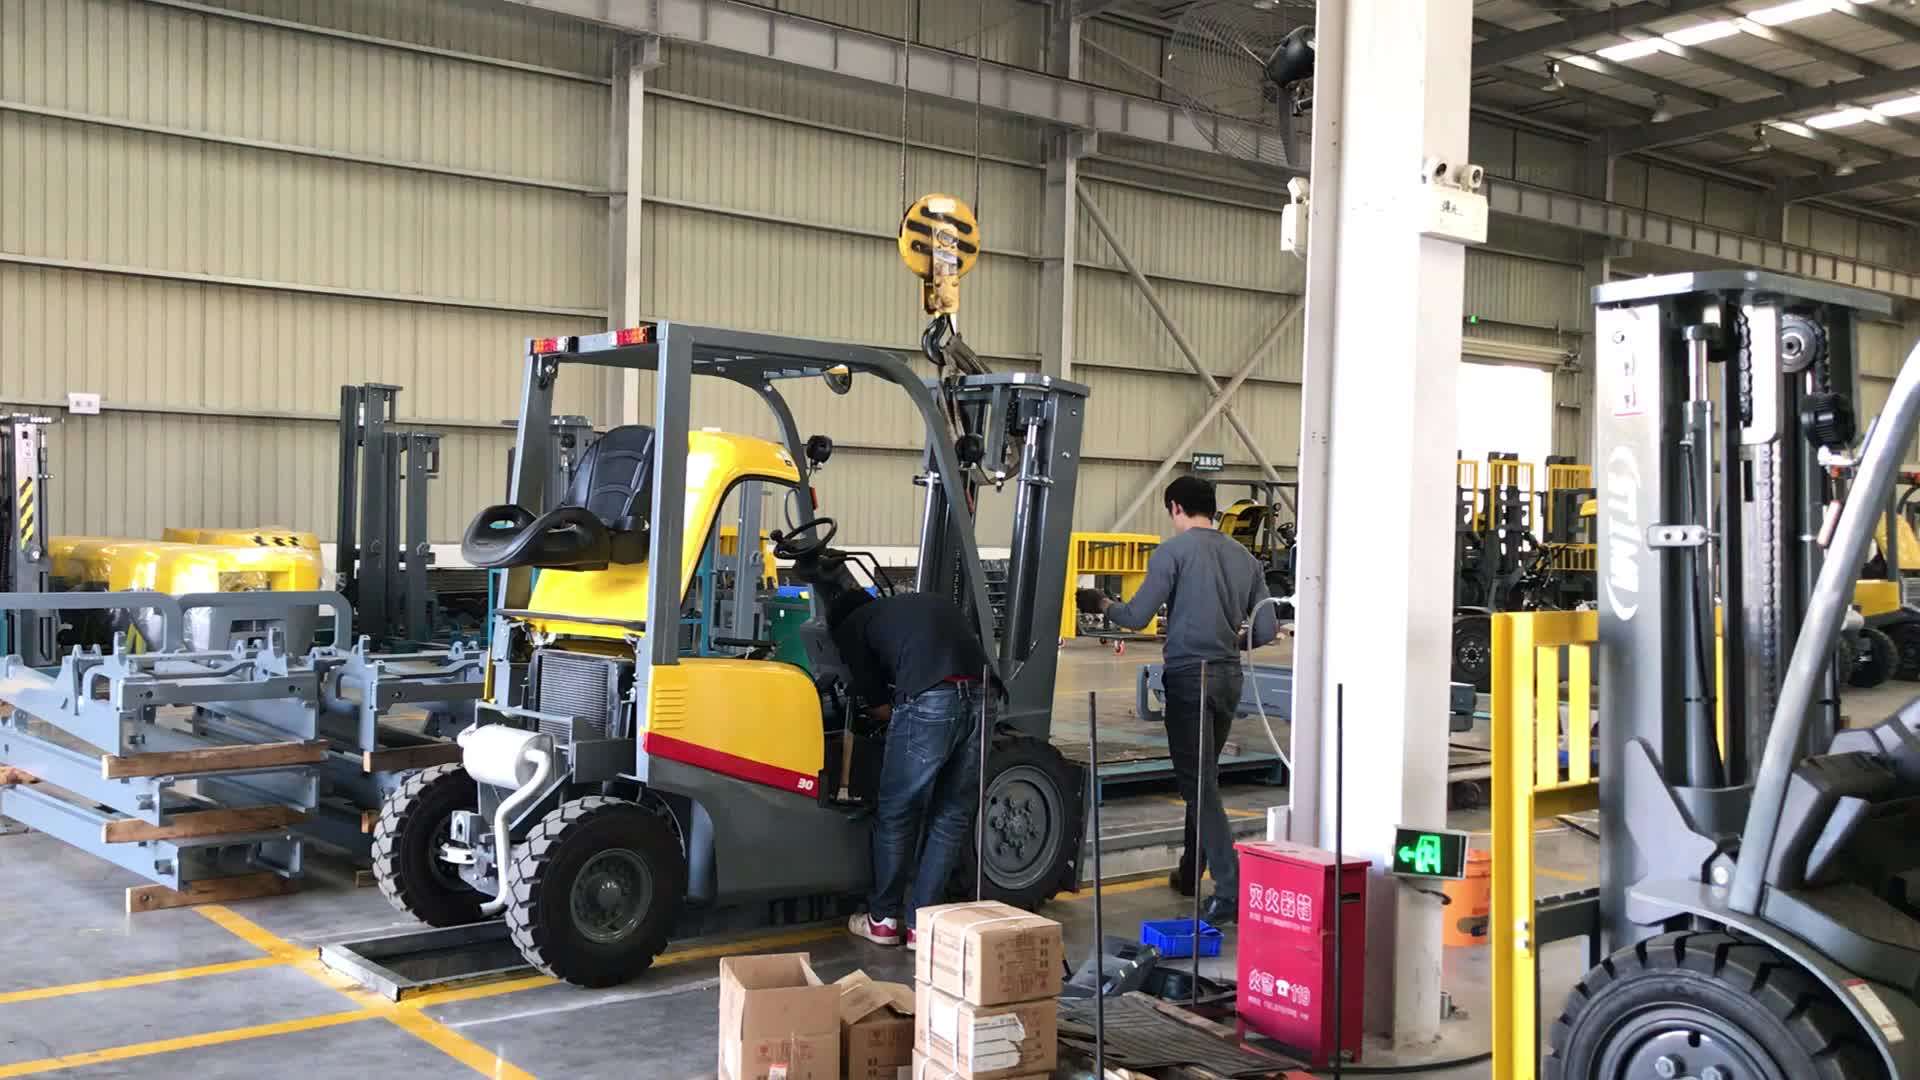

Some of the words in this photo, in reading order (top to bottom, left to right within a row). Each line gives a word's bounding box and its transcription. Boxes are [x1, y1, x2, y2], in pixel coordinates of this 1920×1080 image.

[797, 777, 814, 791] 30
[1248, 882, 1313, 921] 灭火器箱
